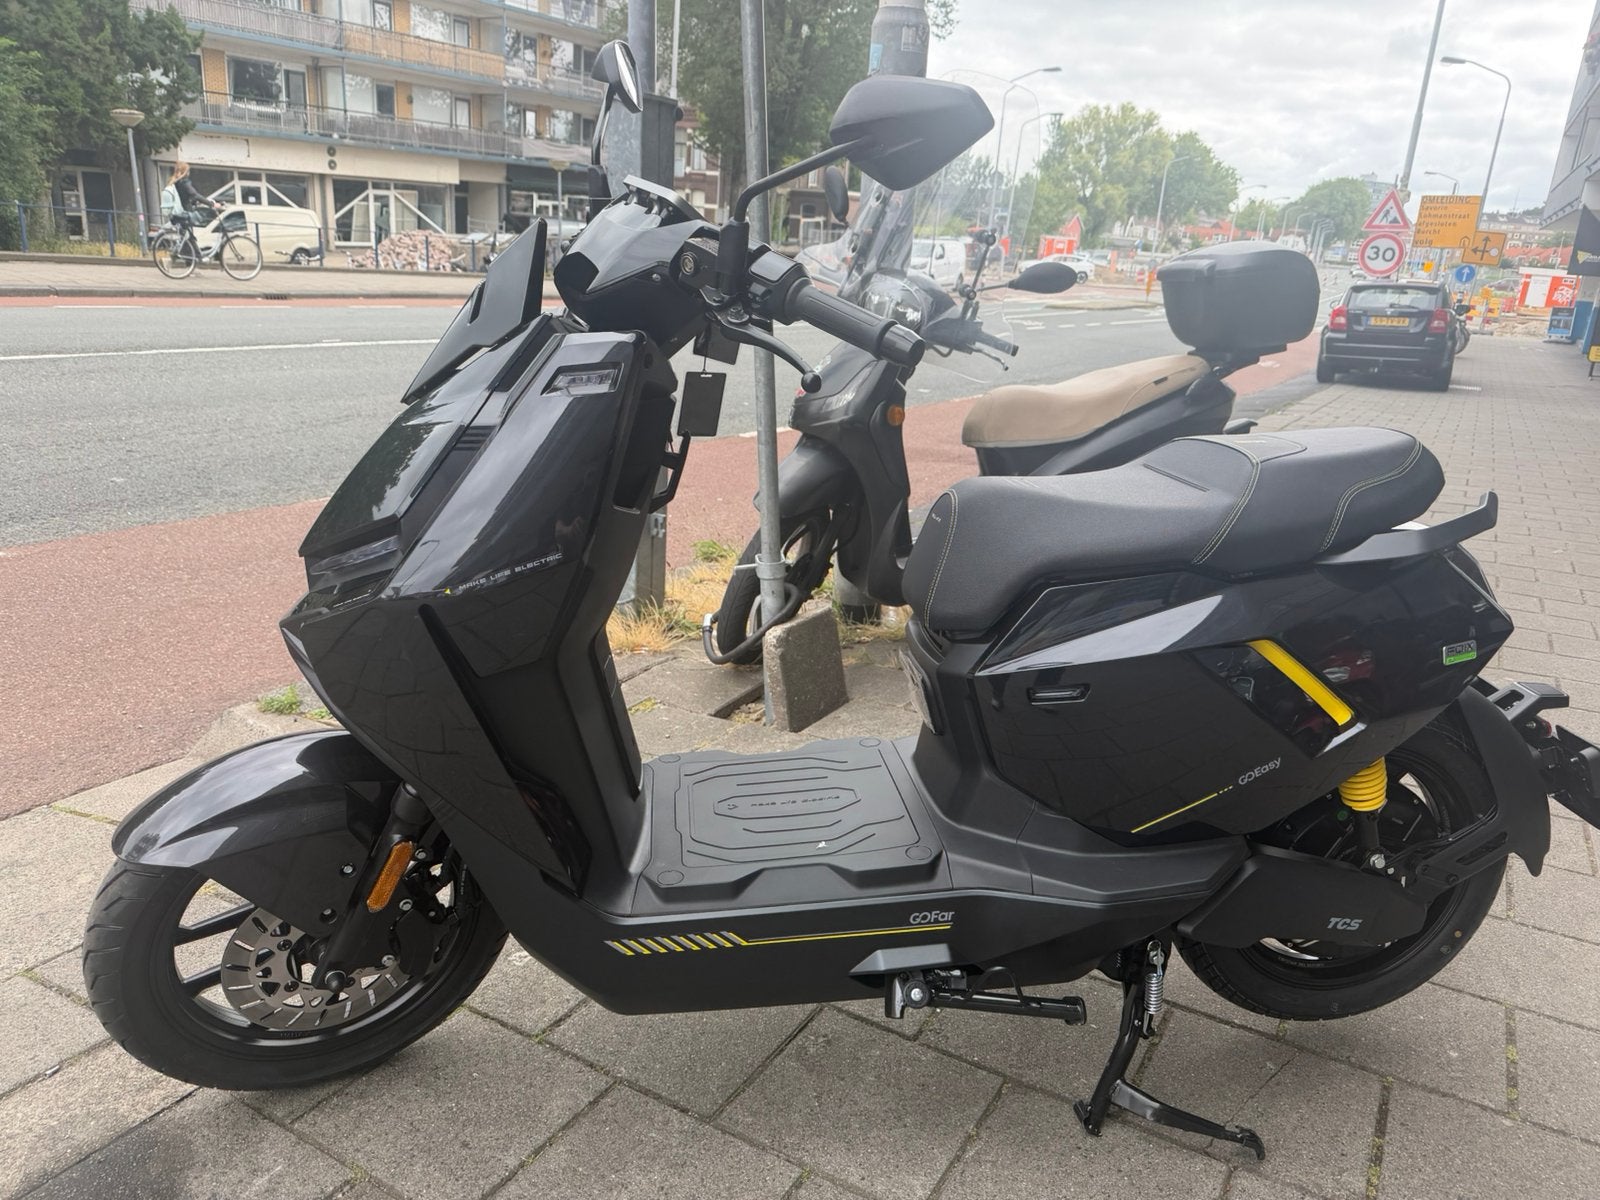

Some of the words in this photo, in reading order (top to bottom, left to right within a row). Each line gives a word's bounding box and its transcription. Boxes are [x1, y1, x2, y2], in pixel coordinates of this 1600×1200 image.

[1420, 195, 1471, 205] OMLEIDING
[1367, 246, 1396, 262] 30
[458, 577, 487, 591] MAKE
[514, 553, 563, 573] ELECTRIC
[1238, 756, 1281, 785] GOEasy
[910, 910, 955, 924] GOFar
[1327, 917, 1363, 930] TCS
